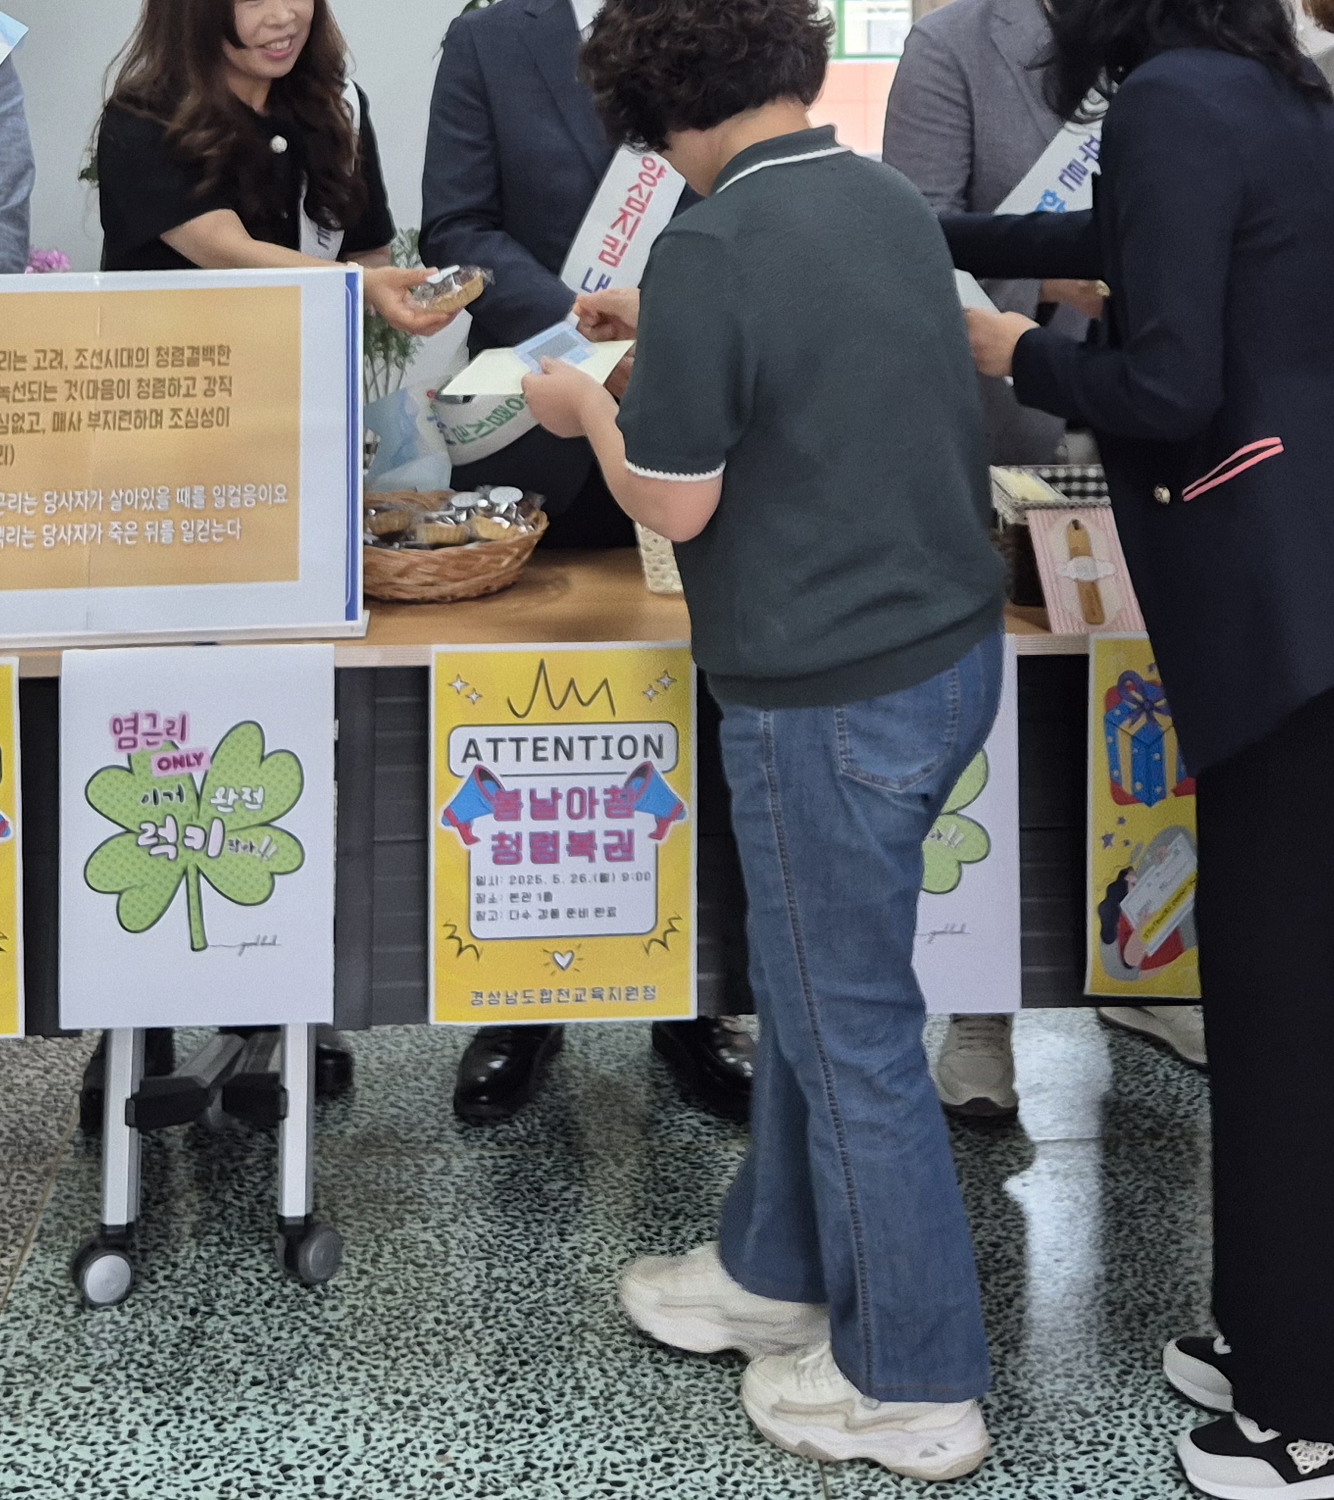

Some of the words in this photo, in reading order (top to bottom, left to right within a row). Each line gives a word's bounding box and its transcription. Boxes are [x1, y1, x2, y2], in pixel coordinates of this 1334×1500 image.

[597, 155, 668, 268] 양심지킴
[32, 348, 68, 372] 고려,
[73, 346, 150, 371] 조선시대의
[155, 344, 232, 369] 청렴결백한
[136, 375, 198, 401] 청렴하고
[203, 374, 233, 399] 강직
[52, 410, 83, 433] 매사
[86, 408, 164, 432] 부지런하며
[168, 406, 231, 430] 조심성이
[43, 488, 104, 516] 당사자가
[109, 485, 171, 513] 살아있을
[176, 484, 206, 511] 때를
[41, 522, 104, 550] 당사자가
[108, 520, 139, 546] 죽은
[144, 518, 175, 546] 뒤를
[112, 711, 187, 750] 염근리
[156, 751, 205, 772] ONLY
[461, 733, 665, 764] ATTENTION
[140, 783, 185, 806] 이거
[210, 785, 265, 814] 완전
[493, 785, 636, 823] 봄날아침
[136, 813, 226, 861] 럭키
[490, 828, 636, 866] 청렴복권
[469, 984, 657, 1007] 경상남도합천교육지원청
